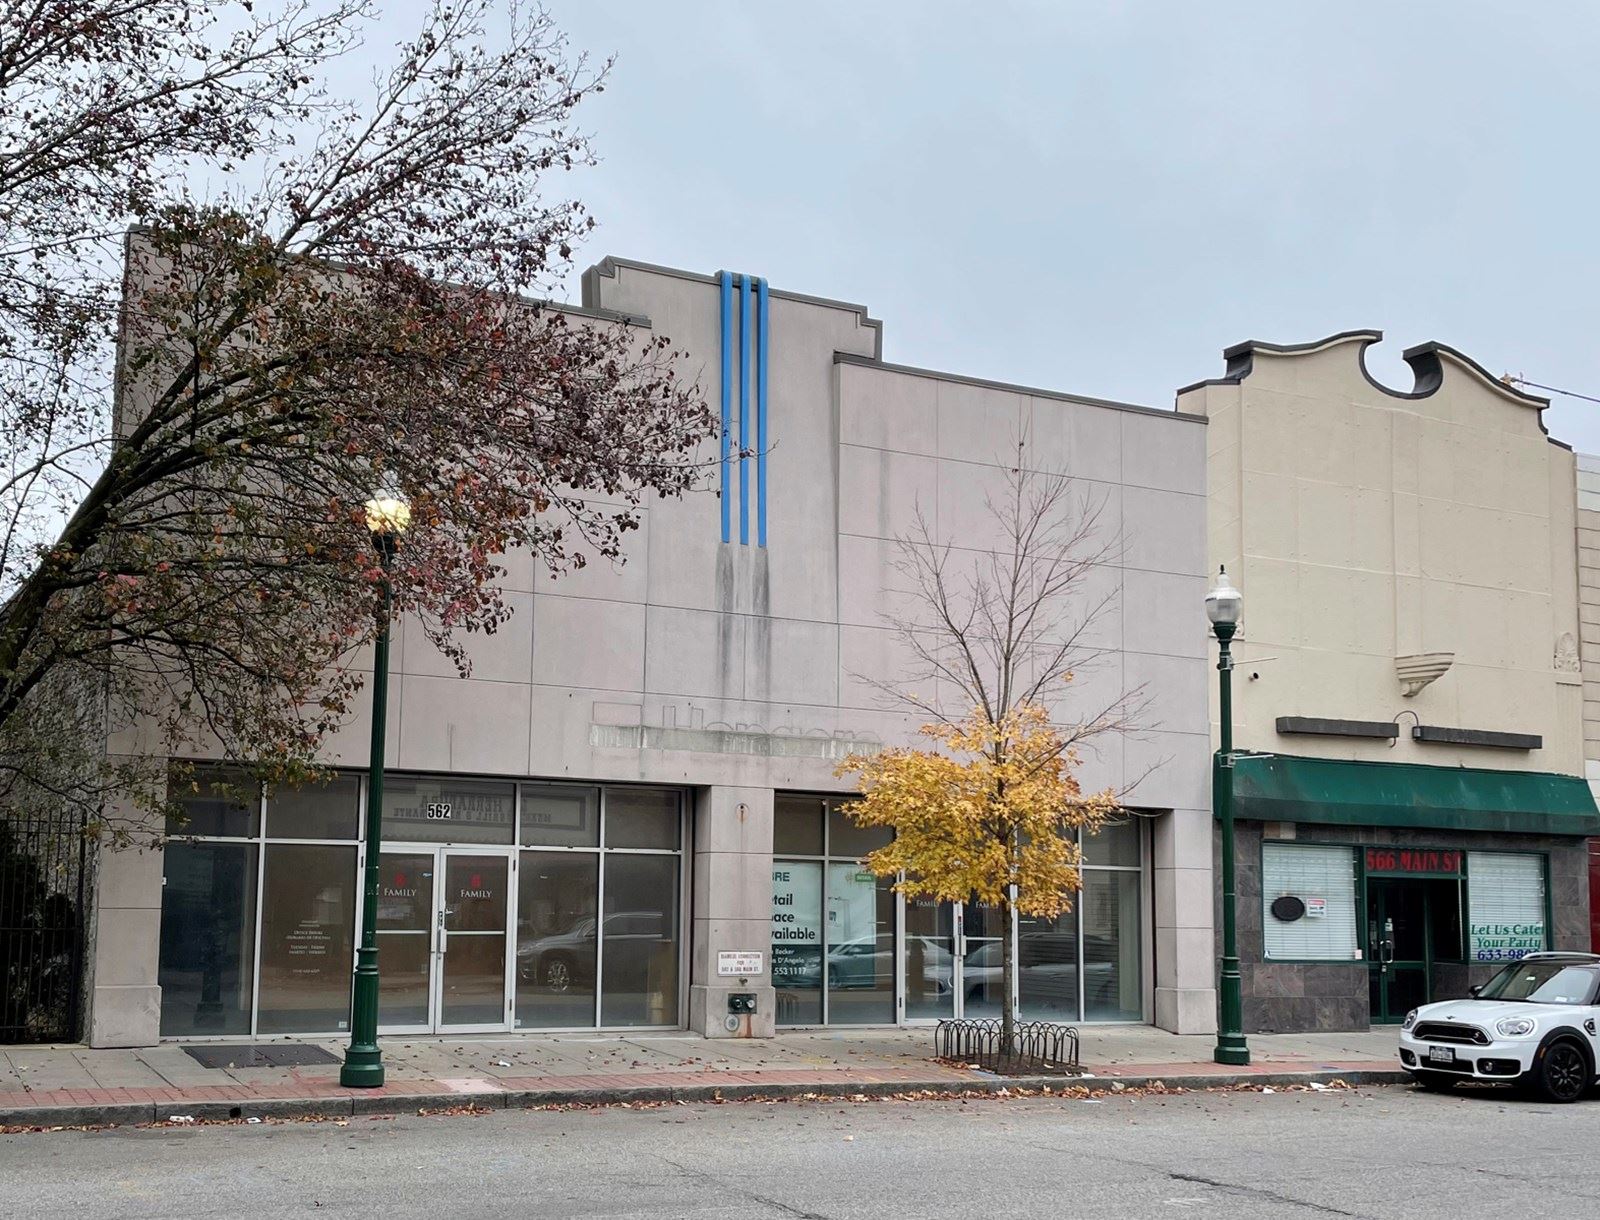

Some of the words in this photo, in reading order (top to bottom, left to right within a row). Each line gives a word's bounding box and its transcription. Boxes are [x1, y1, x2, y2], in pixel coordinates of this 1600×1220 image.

[427, 803, 450, 819] 562
[1367, 850, 1396, 871] 566
[1400, 850, 1438, 872] MAIN
[772, 872, 790, 882] RE
[384, 888, 416, 896] FAMILY
[460, 889, 492, 898] FAMILY
[773, 893, 793, 906] tail
[772, 913, 795, 923] ace
[1471, 924, 1490, 936] Let
[1495, 924, 1510, 936] Us
[1477, 937, 1505, 949] Your
[1509, 937, 1541, 949] Party
[1477, 949, 1540, 961] 633-98
[774, 967, 788, 975] 553
